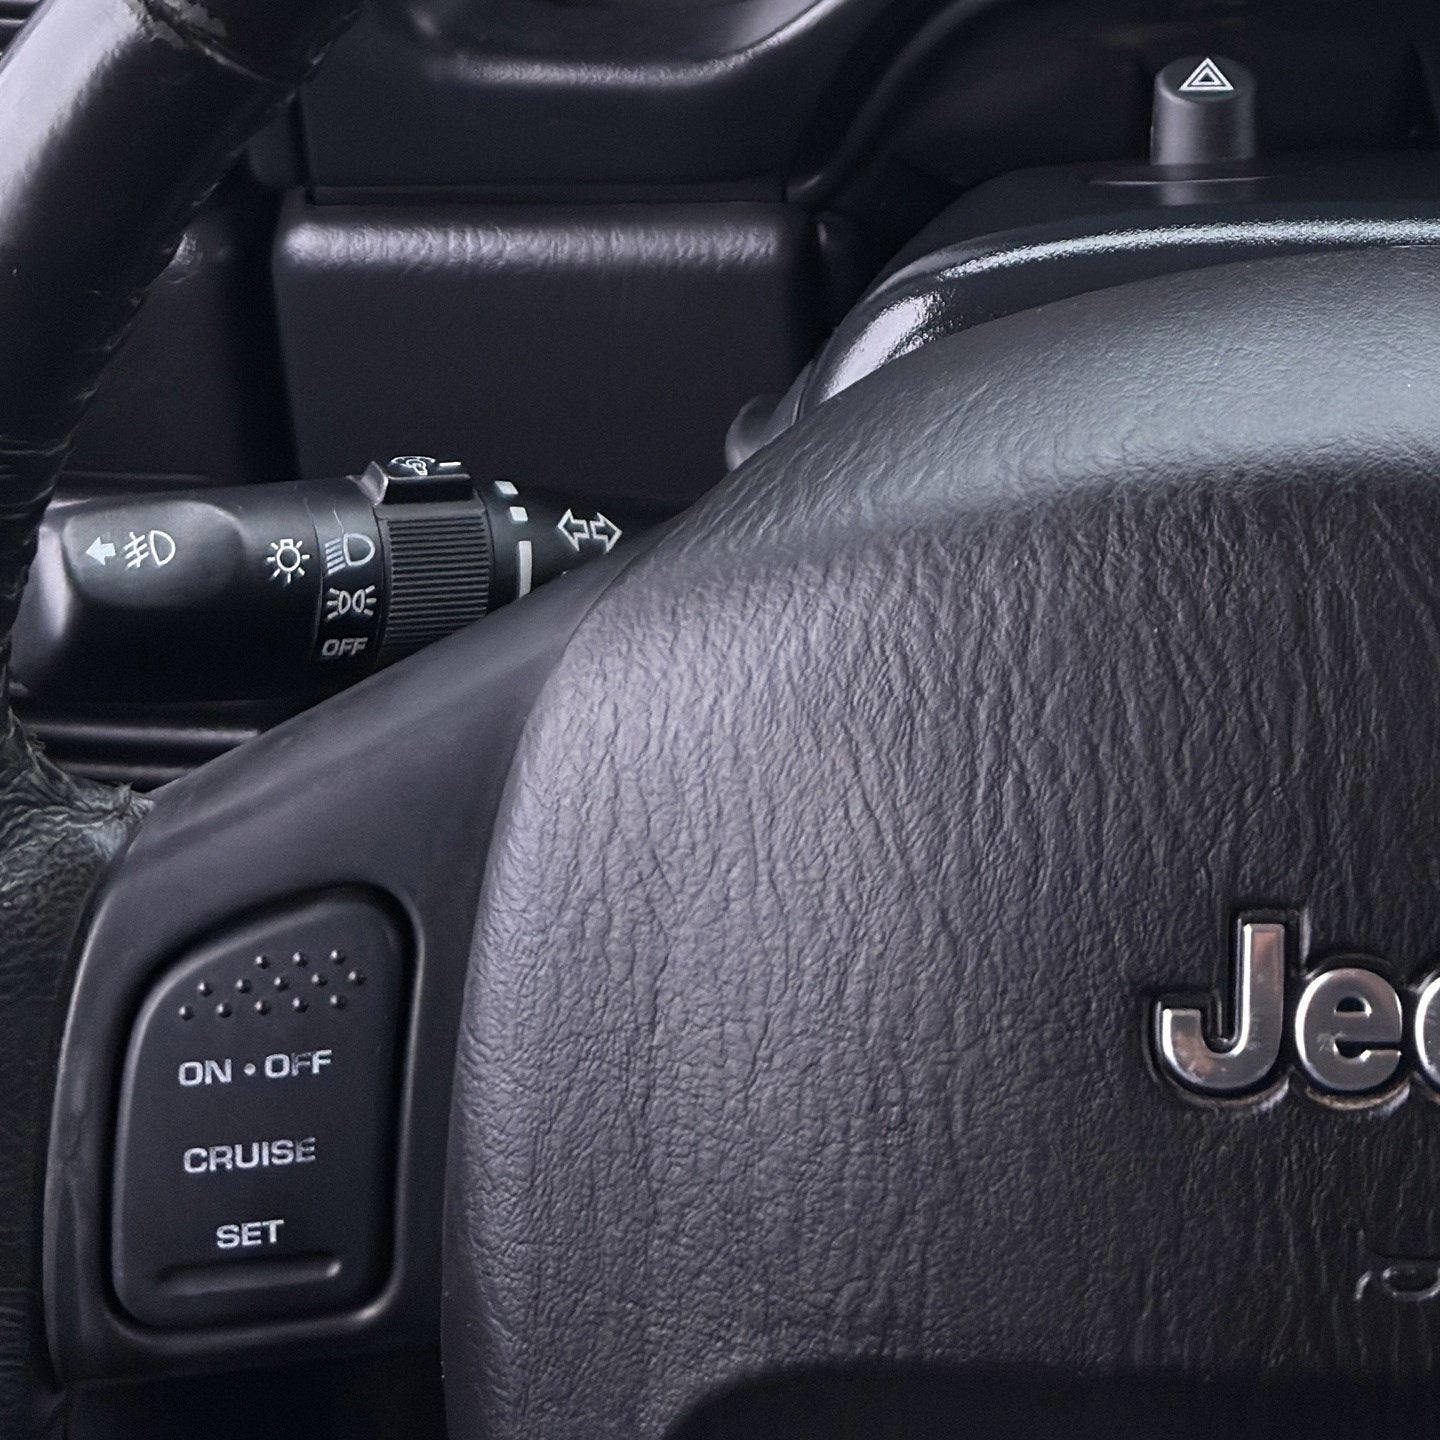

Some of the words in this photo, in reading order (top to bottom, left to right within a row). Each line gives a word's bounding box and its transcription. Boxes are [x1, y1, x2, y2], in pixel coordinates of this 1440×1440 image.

[320, 636, 370, 659] OFF
[177, 1058, 233, 1087] ON
[264, 1049, 333, 1079] OFF
[182, 1136, 318, 1174] CRUISE
[216, 1219, 285, 1249] SET
